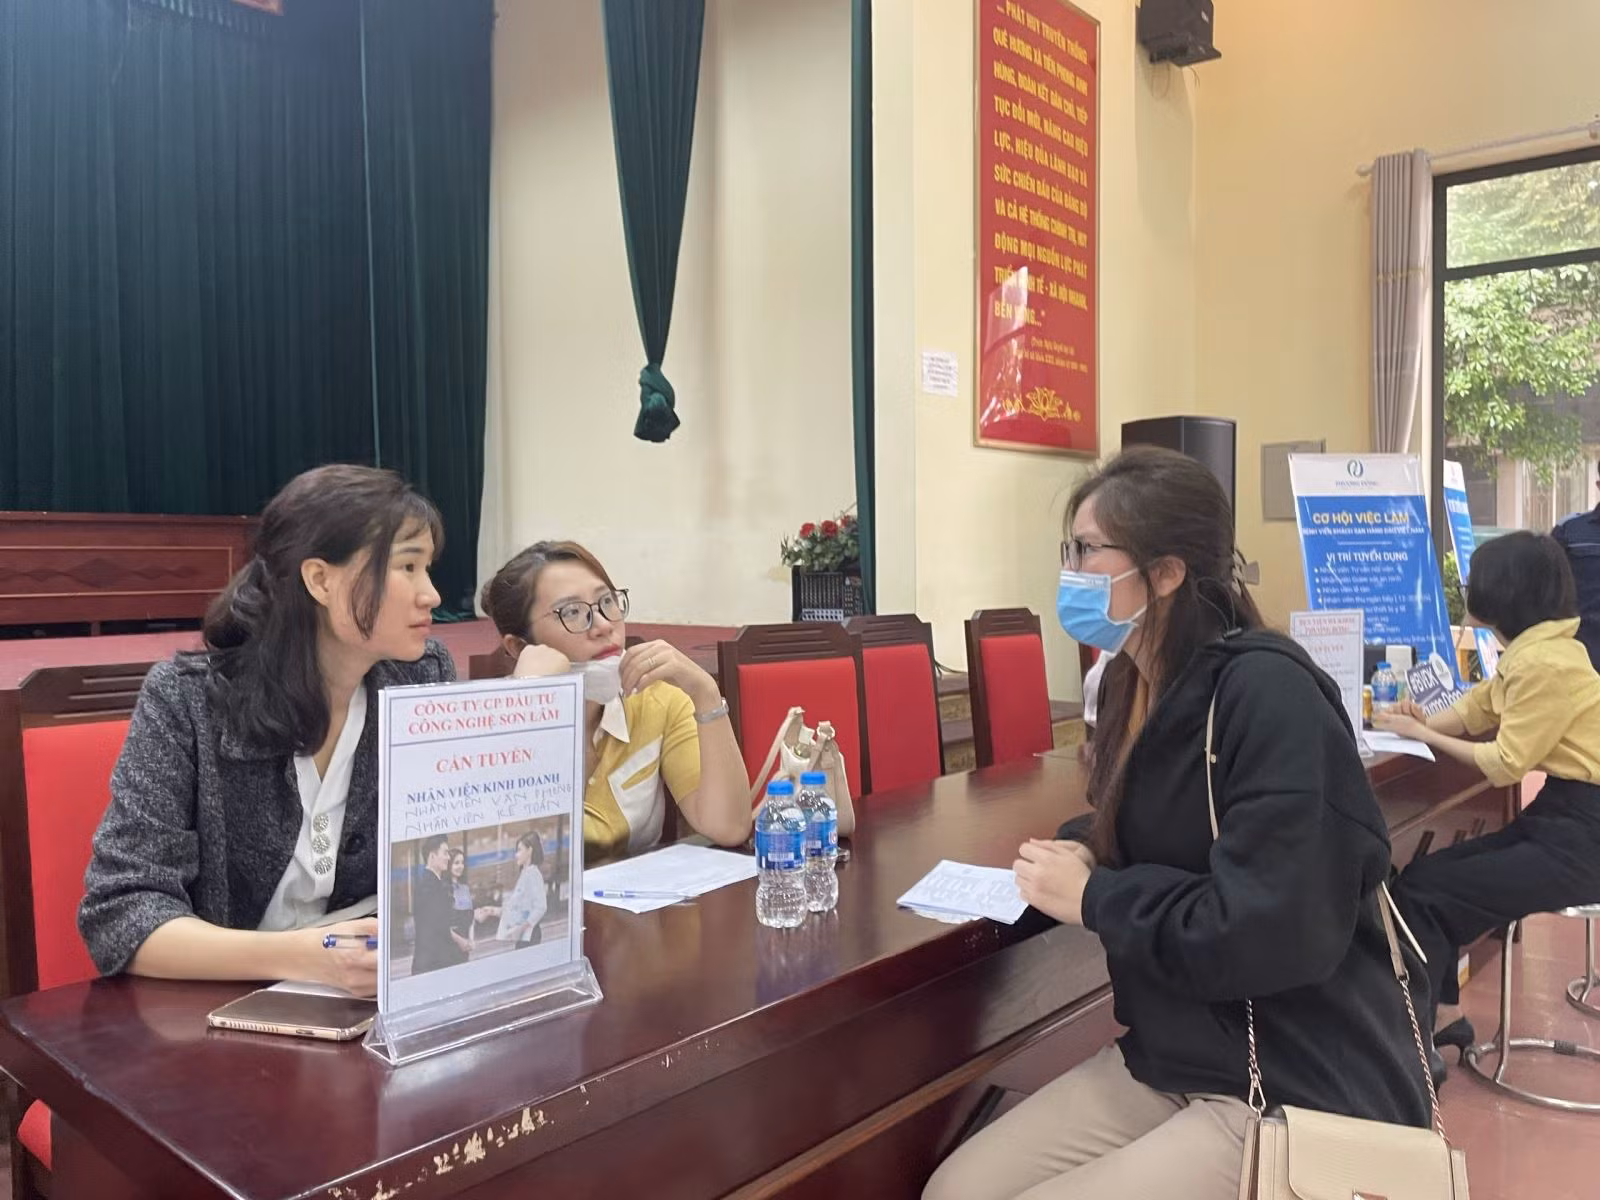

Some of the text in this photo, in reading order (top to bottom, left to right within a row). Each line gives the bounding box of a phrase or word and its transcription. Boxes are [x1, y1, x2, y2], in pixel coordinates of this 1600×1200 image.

[1006, 1, 1024, 24] PHÁT
[1027, 14, 1039, 33] HUY
[1042, 24, 1065, 50] TRUYỀN
[1067, 40, 1087, 63] THỐNG
[993, 26, 1007, 49] QUÊ
[1010, 36, 1032, 60] HƯƠNG
[1034, 48, 1042, 66] XÃ
[1057, 65, 1074, 86] PHONG
[1018, 72, 1036, 95] ĐOÀN
[1038, 83, 1048, 102] KẾT
[994, 96, 1010, 118] TỤC
[1012, 98, 1024, 122] ĐỔI
[1044, 119, 1061, 141] NÂNG
[1063, 131, 1073, 148] CAO
[1075, 137, 1087, 157] HIỆU
[1016, 137, 1033, 161] HIỆU
[1035, 143, 1048, 168] QUẢ
[1050, 154, 1065, 174] LÃNH
[1067, 164, 1078, 183] ĐẠO
[994, 162, 1087, 219] SỨC CHIẾN ĐẤU CỦA ĐẢNG BỘ
[995, 196, 1005, 216] VÀ
[1007, 198, 1016, 219] CẢ
[1019, 206, 1028, 224] HỆ
[1030, 209, 1049, 230] THỐNG
[1051, 217, 1066, 237] CHÍNH
[1078, 232, 1086, 246] HUY
[994, 231, 1086, 277] ĐỘNG MỌI NGUỒN LỰC PHÁT
[1036, 274, 1044, 294] TẾ
[1049, 282, 1056, 296] XÃ
[1058, 286, 1067, 303] HỘI
[1312, 509, 1409, 526] CƠ HỘI VIỆC LÀM
[1318, 527, 1332, 536] VIỆN
[1326, 548, 1408, 564] VỊ TRÍ TUYỂN DỤNG
[414, 692, 555, 716] CÔNG TY CP ĐẦU TƯ
[409, 709, 560, 736] CÔNG NGHỆ SƠN LÂM
[436, 749, 533, 773] CẦN TUYỂN
[407, 773, 560, 804] NHÂN VIÊN KINH DOANH
